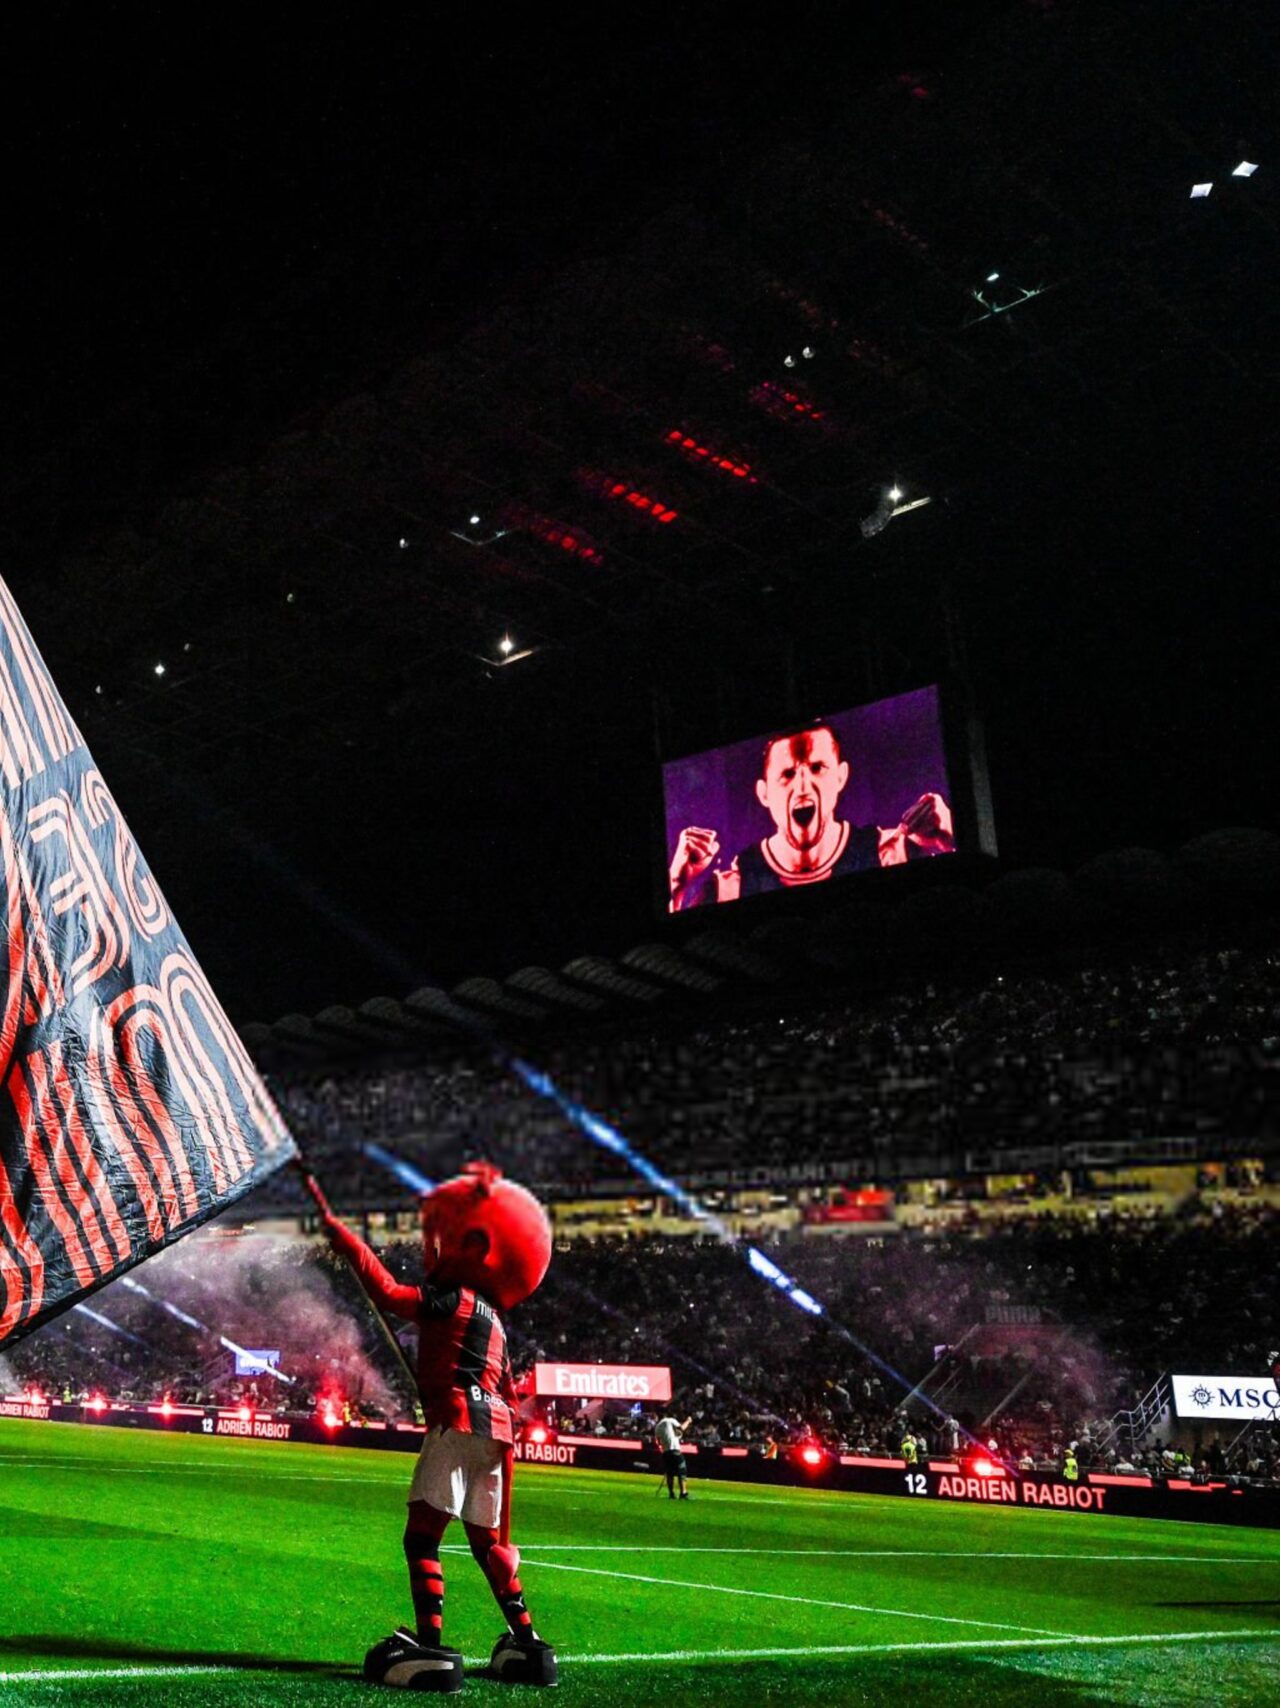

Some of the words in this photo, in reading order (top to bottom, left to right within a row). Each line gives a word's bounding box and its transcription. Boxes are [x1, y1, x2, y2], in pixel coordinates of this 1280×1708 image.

[554, 1367, 650, 1396] Emirates
[1217, 1388, 1280, 1409] MSC
[23, 1405, 50, 1419] RABIOT
[202, 1418, 214, 1433] 12
[217, 1418, 252, 1436] ADRIEN
[254, 1421, 291, 1439] RABIOT
[525, 1444, 577, 1464] RABIOT
[904, 1473, 928, 1495] 12
[938, 1476, 1017, 1502] ADRIEN
[1023, 1482, 1106, 1509] RABIOT
